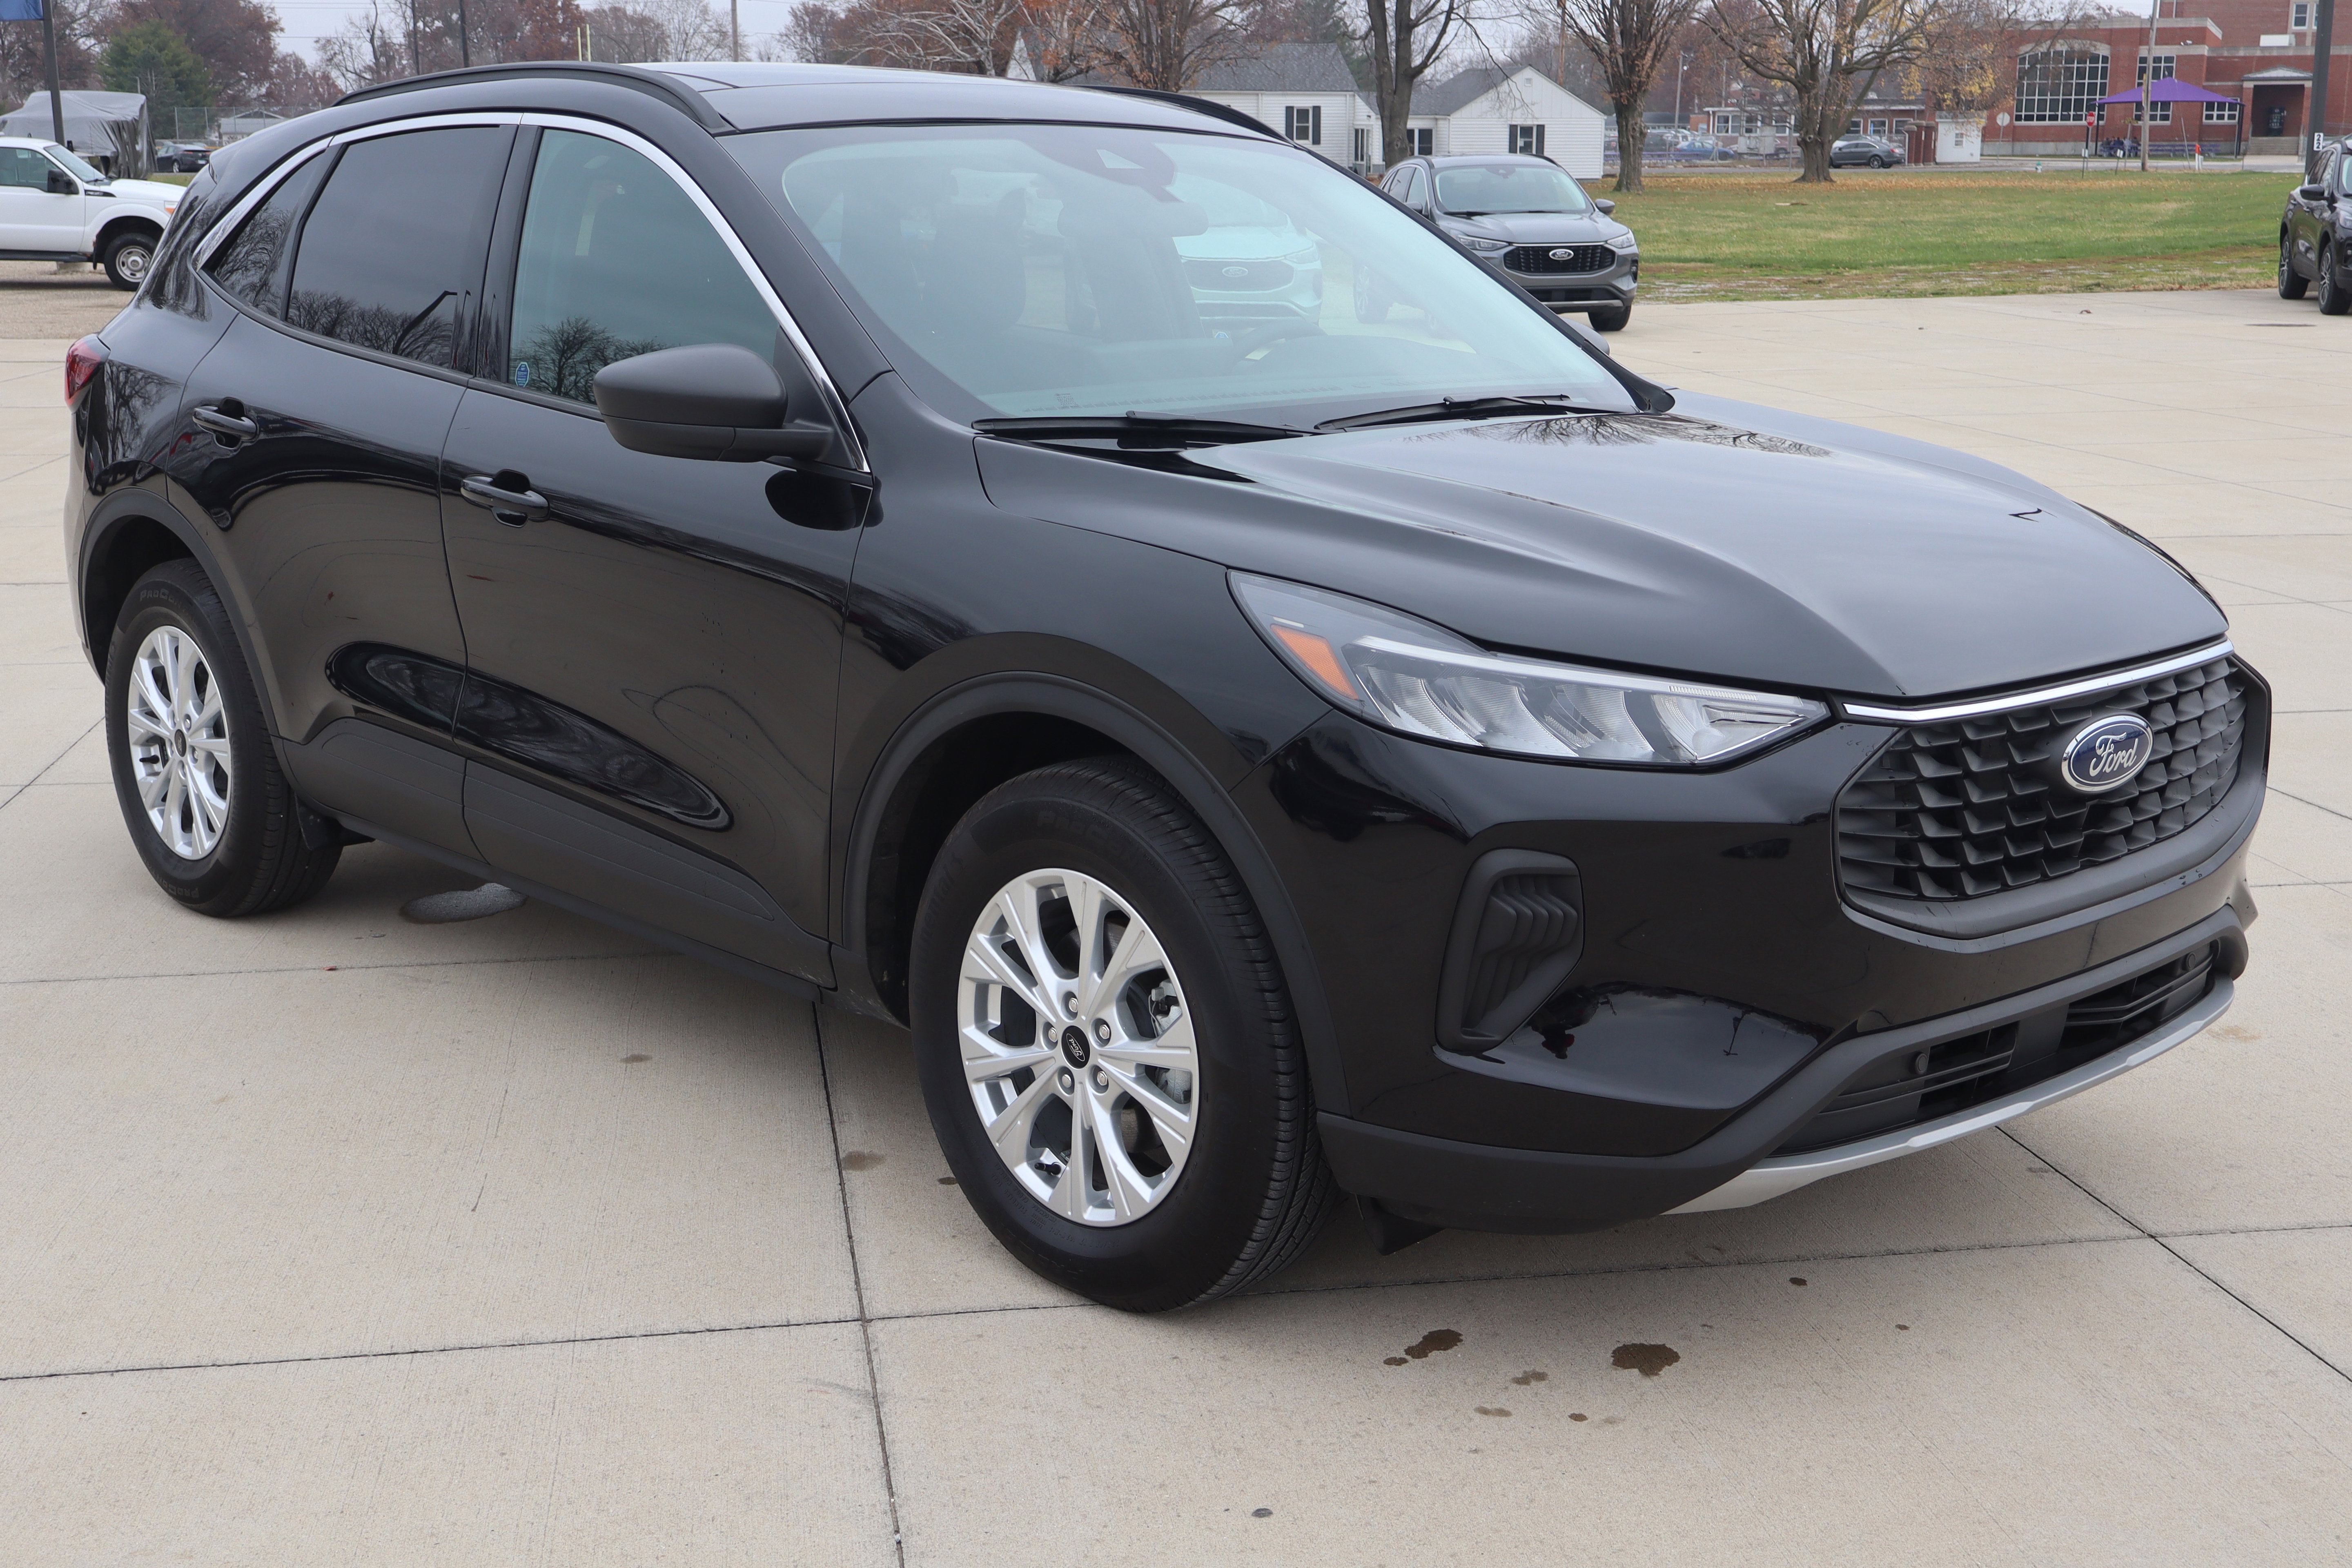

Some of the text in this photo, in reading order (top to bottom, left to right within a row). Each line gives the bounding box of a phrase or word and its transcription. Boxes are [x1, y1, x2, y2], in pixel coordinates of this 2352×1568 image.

[2316, 134, 2321, 149] 22
[2089, 732, 2138, 777] Ford
[1069, 1038, 1082, 1056] Ford
